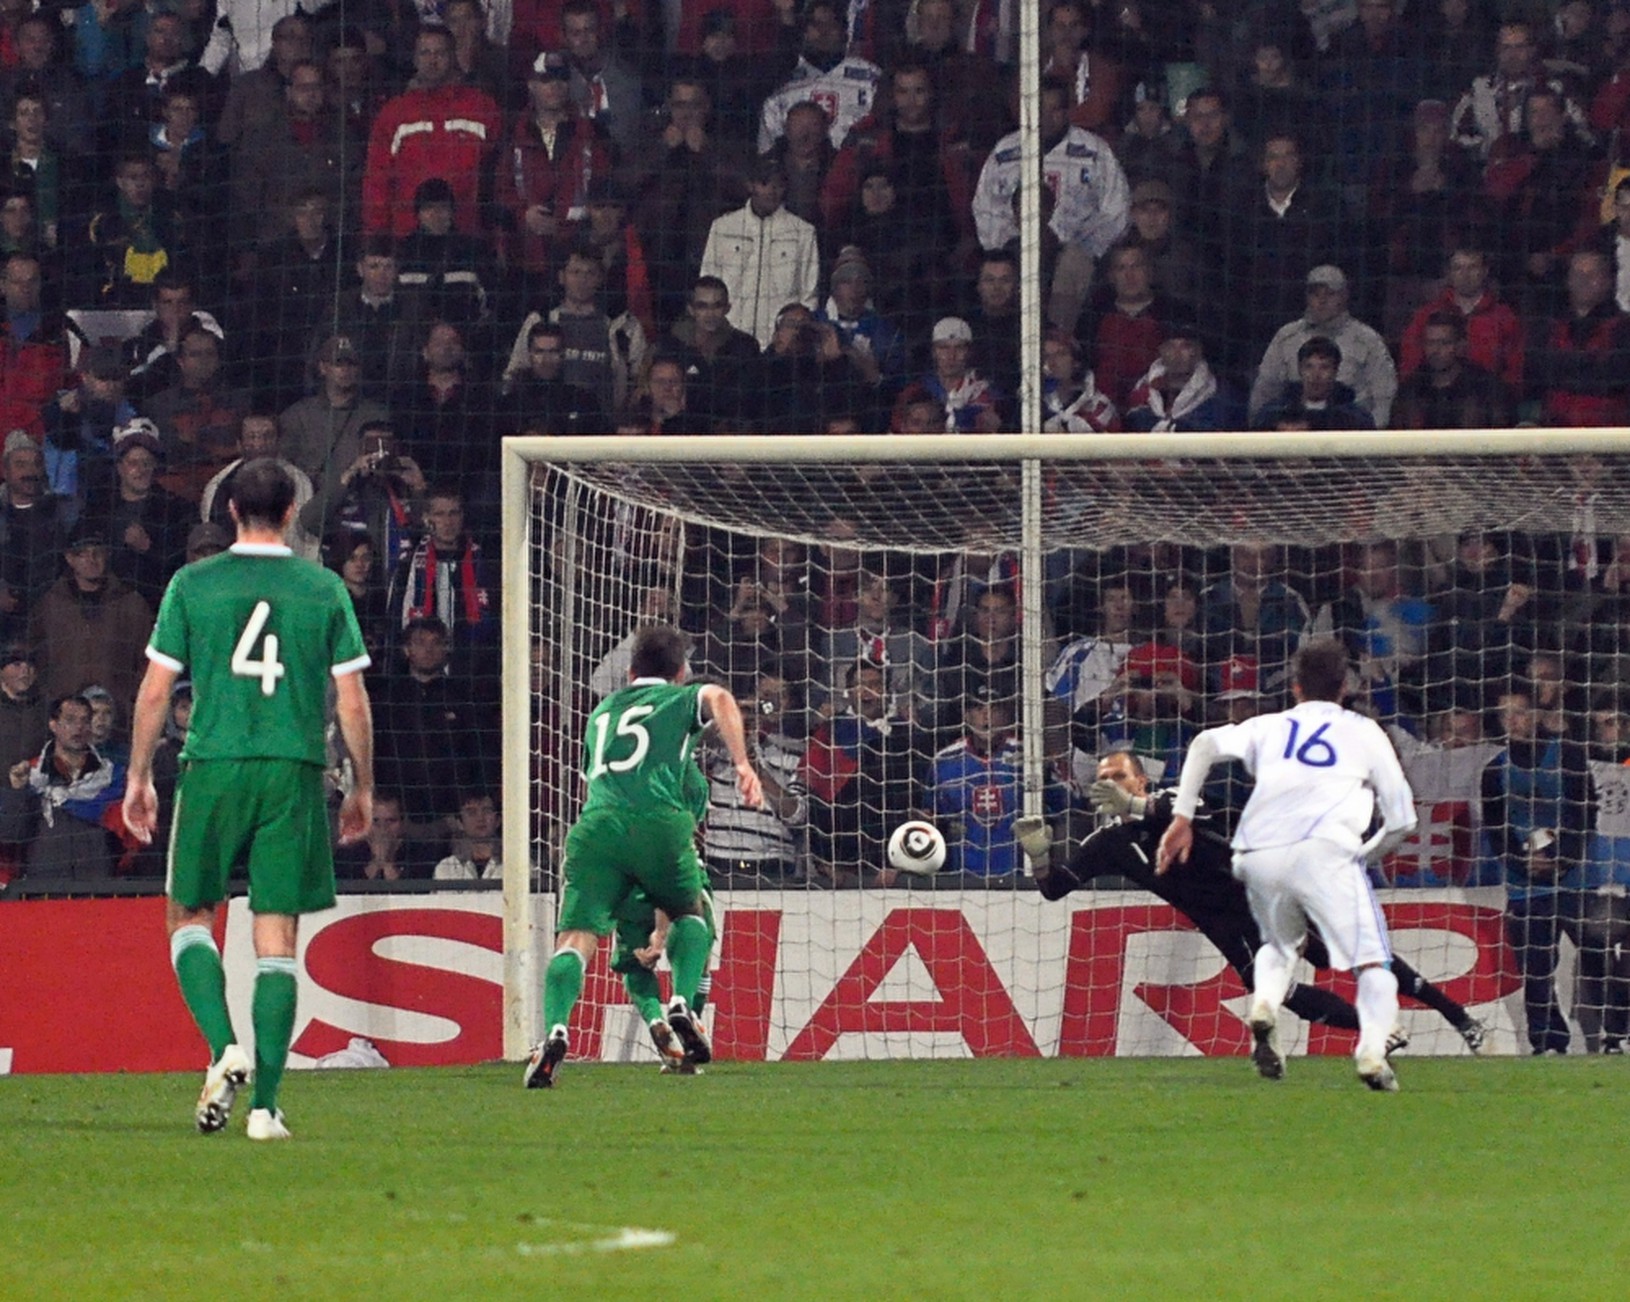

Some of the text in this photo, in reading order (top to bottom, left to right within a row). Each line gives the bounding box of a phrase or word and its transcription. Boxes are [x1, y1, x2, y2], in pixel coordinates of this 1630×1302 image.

[231, 600, 285, 695] 4
[588, 704, 655, 780] 15
[1283, 717, 1338, 768] 16
[292, 903, 1524, 1067] SHARP
